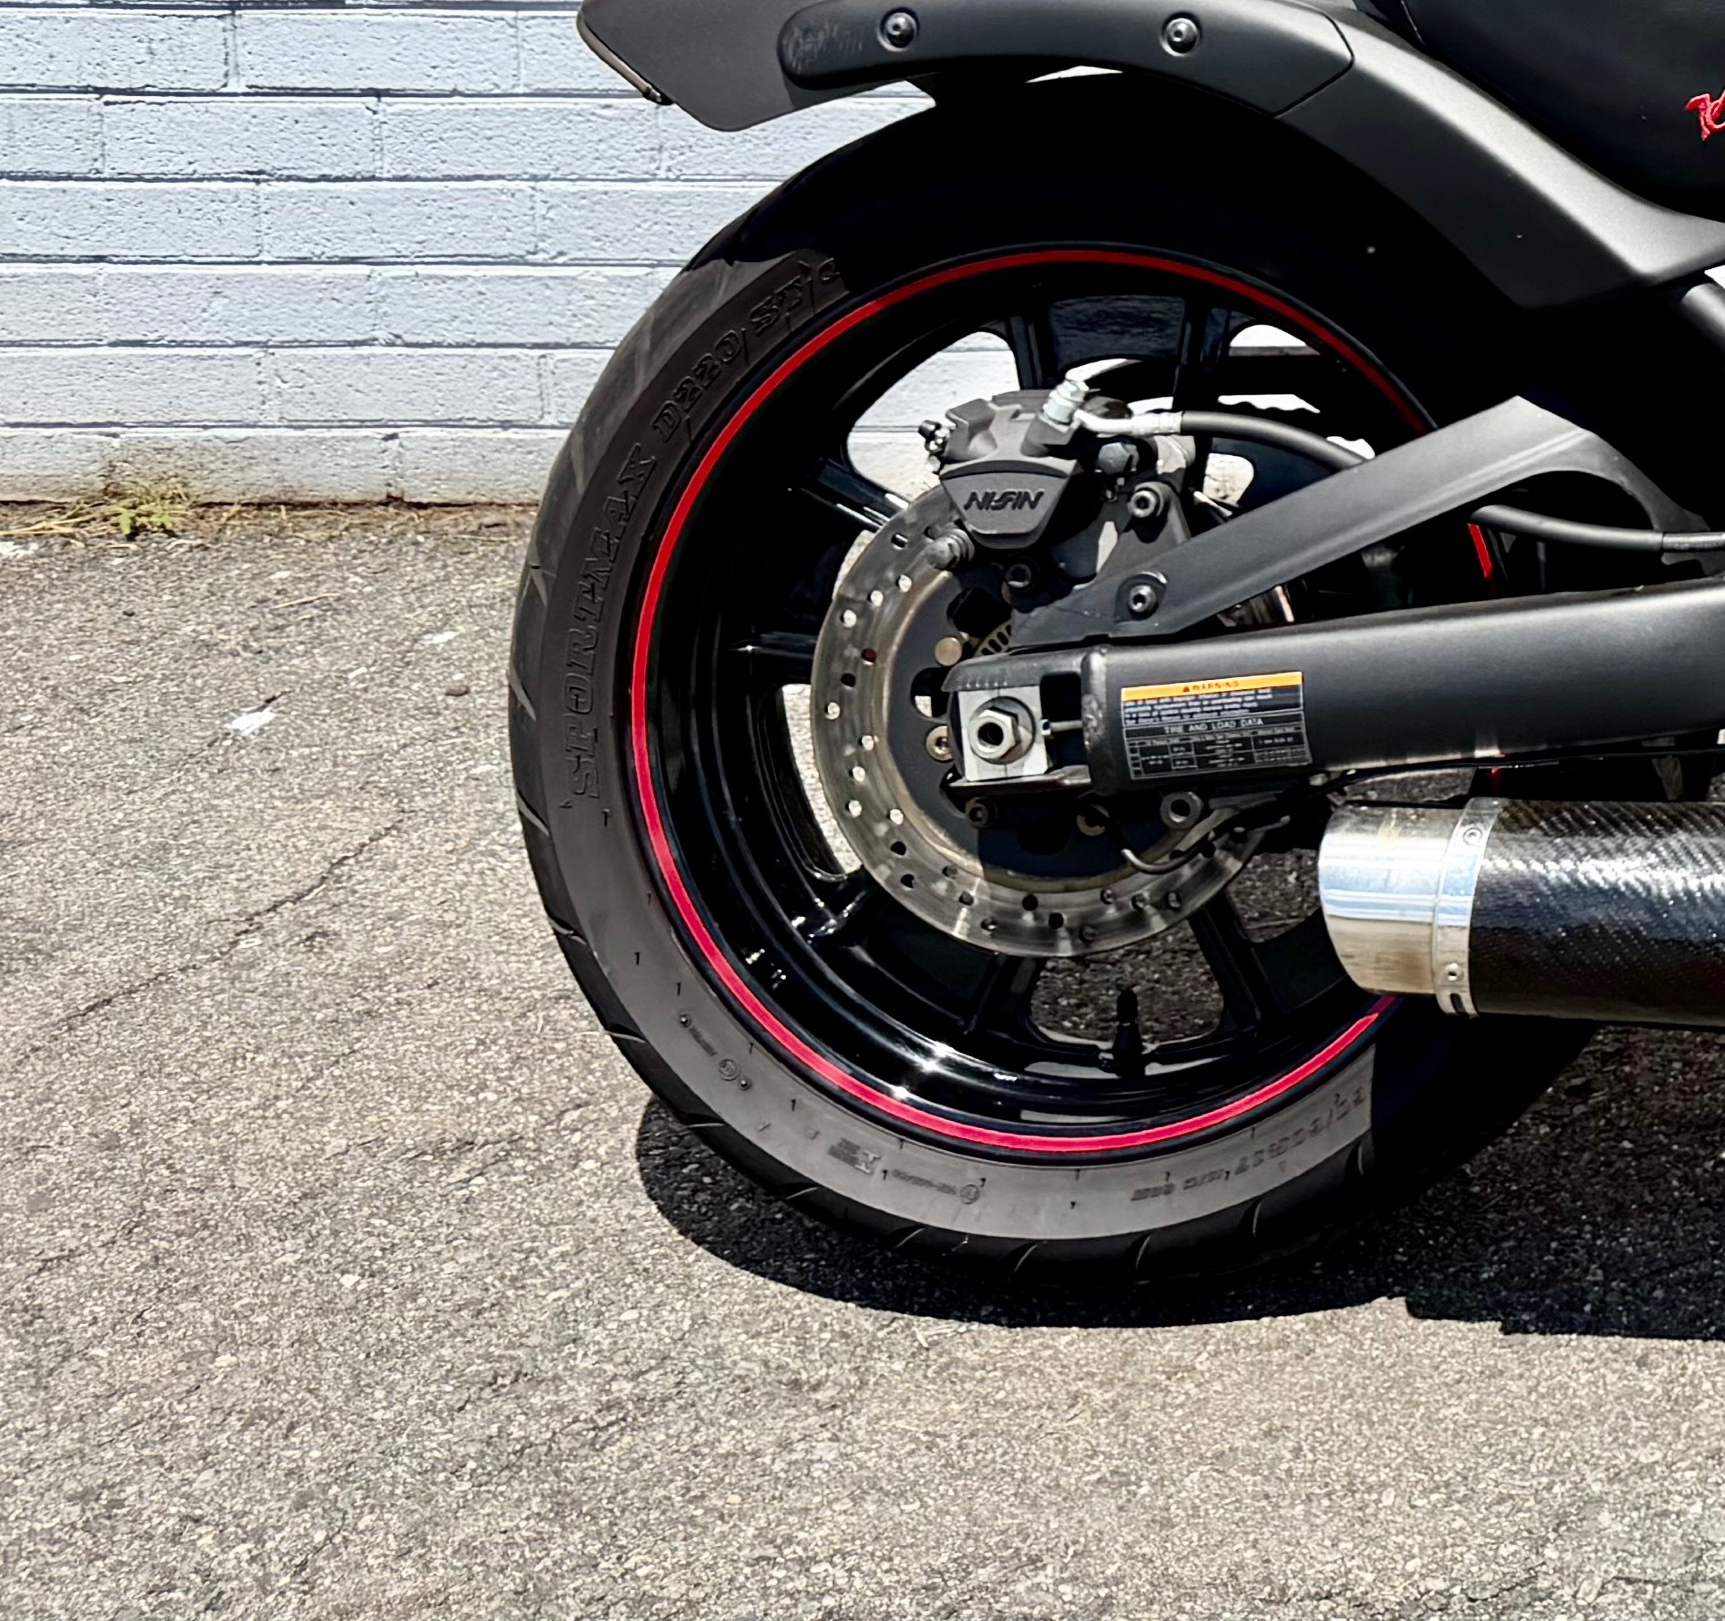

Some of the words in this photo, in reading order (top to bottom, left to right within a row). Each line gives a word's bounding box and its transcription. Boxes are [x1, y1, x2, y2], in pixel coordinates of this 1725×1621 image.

[562, 442, 659, 799] SPORTMAX
[651, 329, 744, 442] D220
[1211, 720, 1237, 730] LOAD
[1240, 717, 1264, 727] DATA
